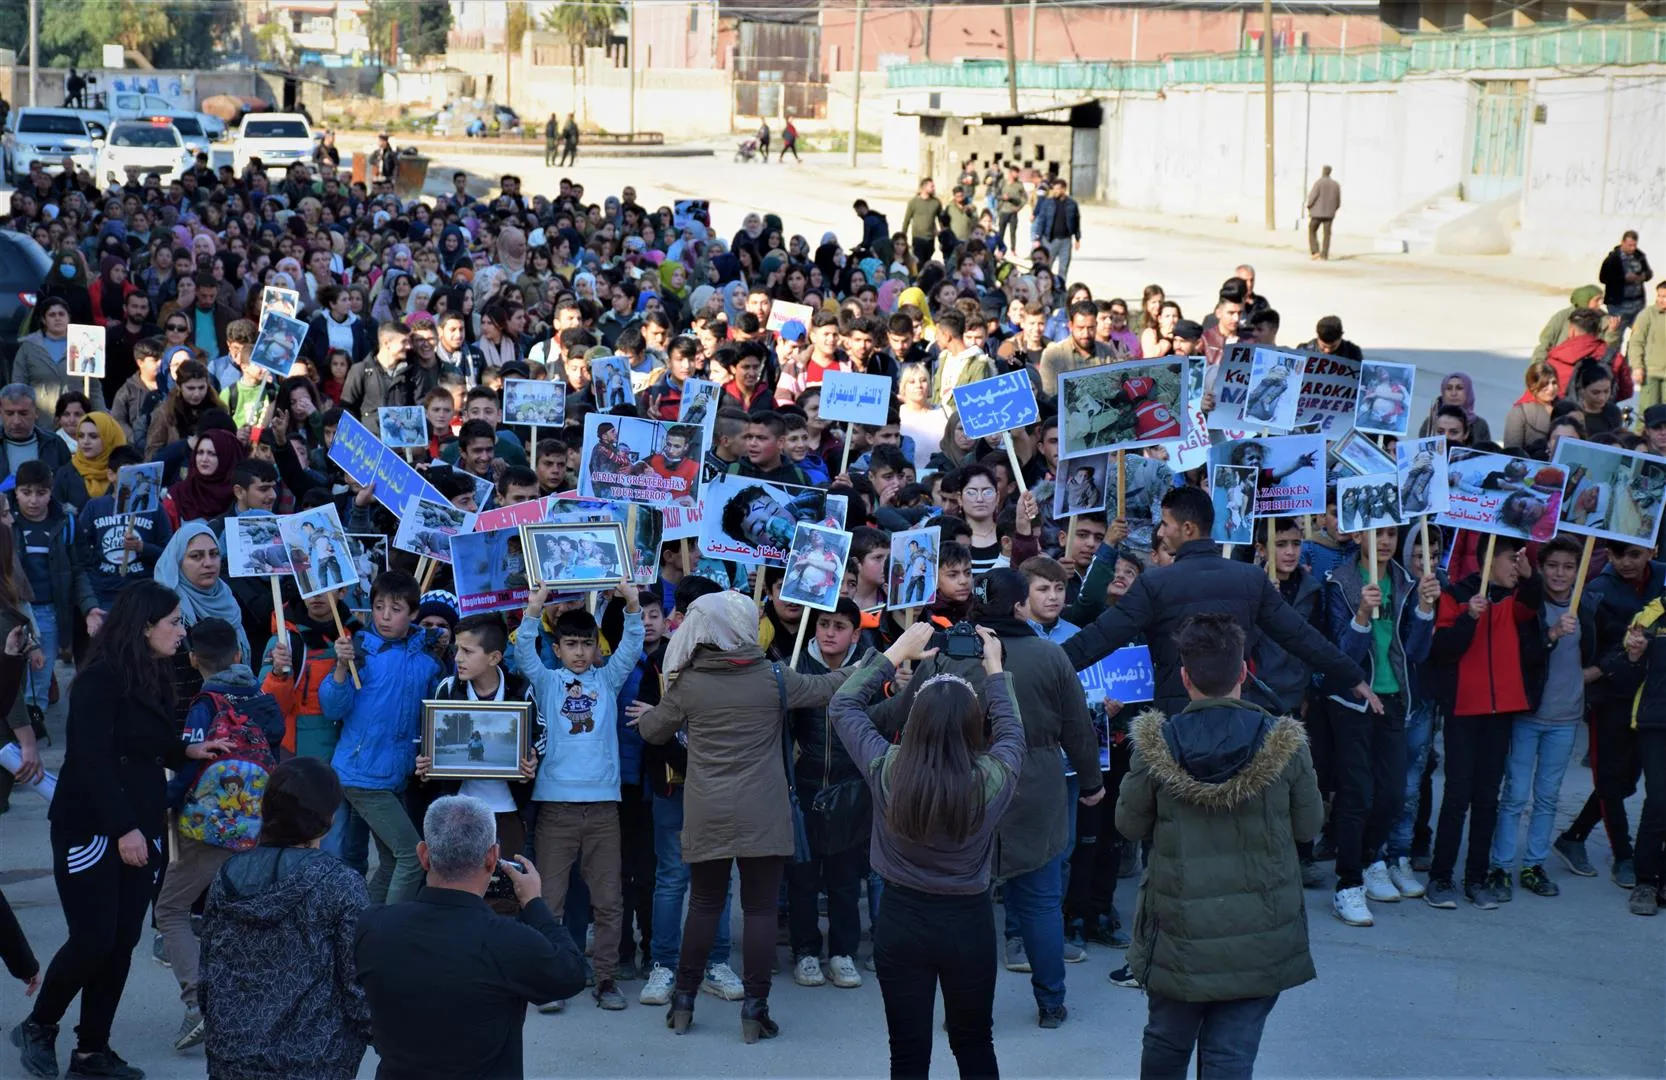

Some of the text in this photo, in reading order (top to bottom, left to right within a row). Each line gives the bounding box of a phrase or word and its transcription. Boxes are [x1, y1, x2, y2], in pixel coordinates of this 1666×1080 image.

[961, 372, 1027, 407] الشهيد
[965, 400, 1032, 430] هو كرامتنا
[592, 471, 617, 484] AFRIN
[625, 474, 663, 489] GREATER
[611, 486, 667, 500] YOUR TERROR
[94, 515, 154, 530] SAINT LUIS
[707, 540, 751, 555] عفرين
